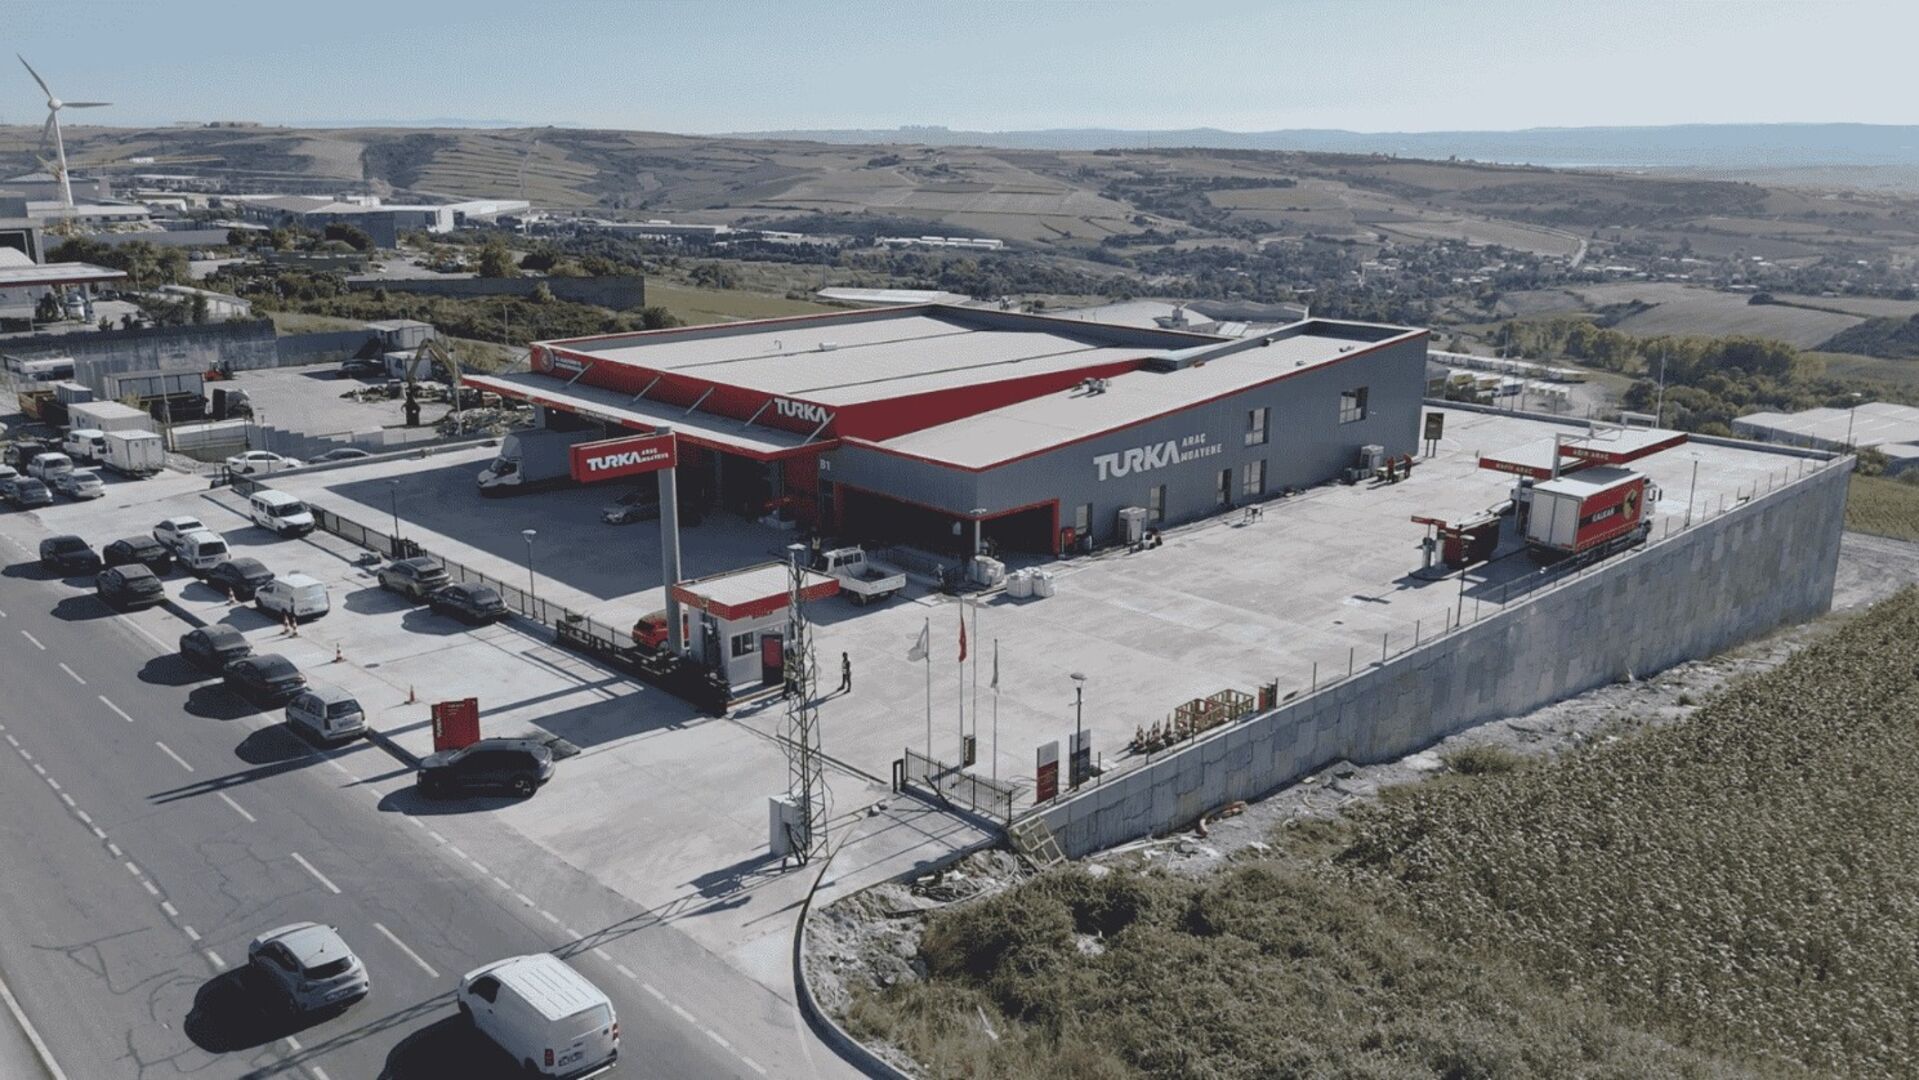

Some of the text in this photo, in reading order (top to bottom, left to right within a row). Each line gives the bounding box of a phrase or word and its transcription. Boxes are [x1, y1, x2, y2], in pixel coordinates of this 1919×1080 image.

[774, 397, 828, 424] TURKA
[587, 451, 642, 471] TURKA
[819, 458, 831, 472] B1
[1093, 440, 1180, 480] TURKA
